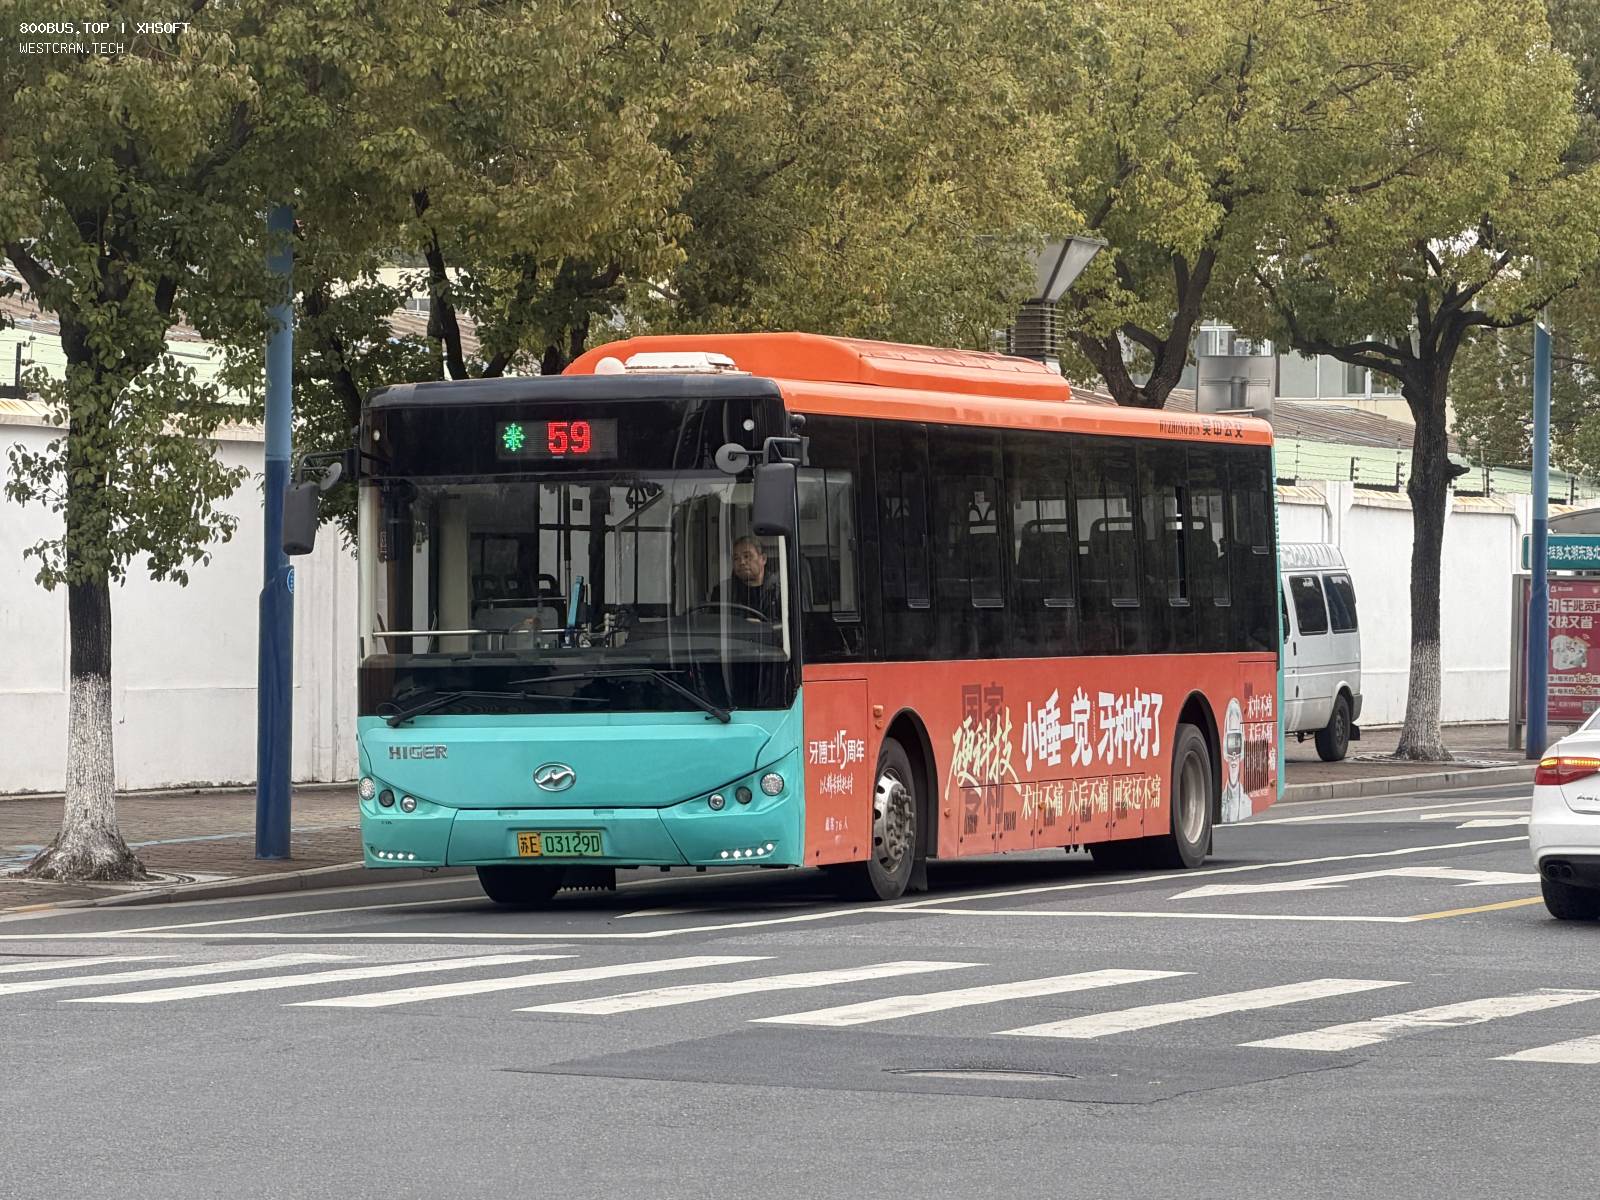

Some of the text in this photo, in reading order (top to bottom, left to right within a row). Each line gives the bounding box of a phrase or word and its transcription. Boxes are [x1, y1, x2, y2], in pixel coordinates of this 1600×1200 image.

[547, 421, 591, 453] 59
[1201, 417, 1244, 438] 吴中公交
[1022, 686, 1093, 773] 小睡一觉
[1097, 687, 1163, 767] 牙种好了
[389, 745, 448, 759] HIGER
